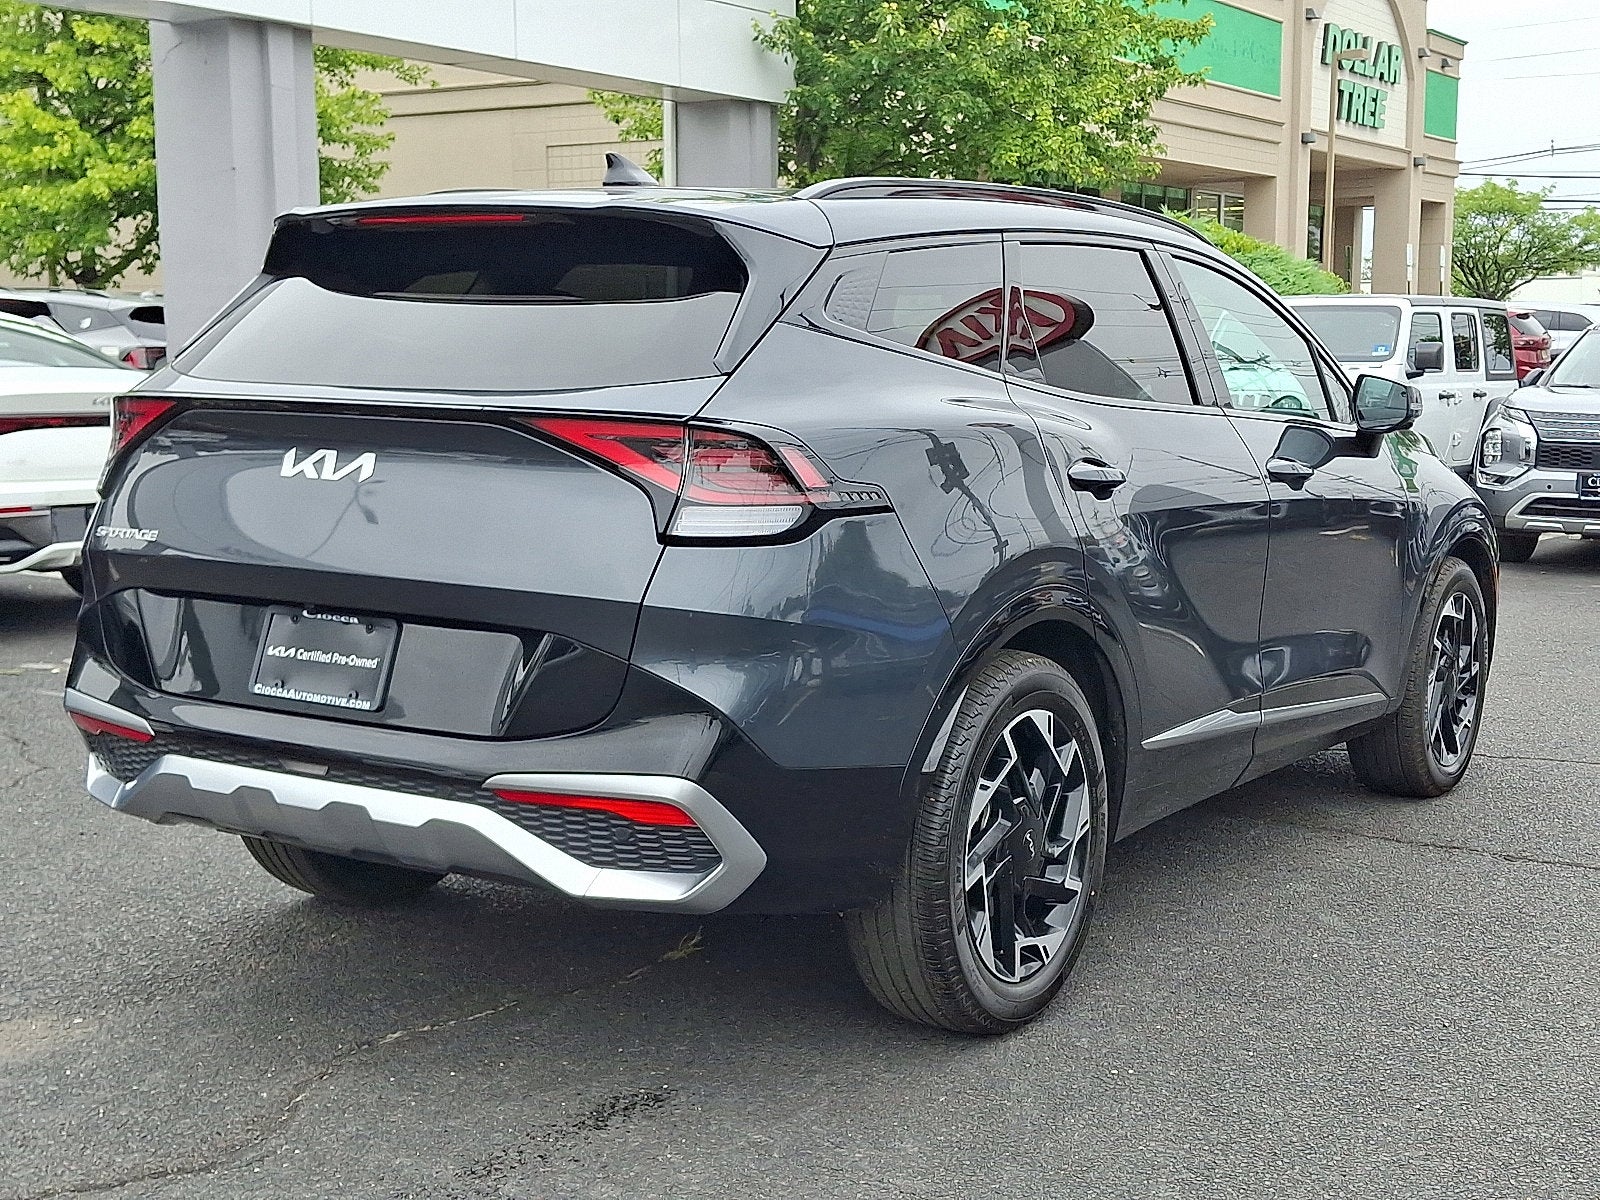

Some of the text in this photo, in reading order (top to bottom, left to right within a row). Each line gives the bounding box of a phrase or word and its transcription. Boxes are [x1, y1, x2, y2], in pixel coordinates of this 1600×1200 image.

[1321, 23, 1403, 84] DOLLAR
[1336, 79, 1388, 129] TREE
[280, 446, 377, 483] KIA
[297, 648, 333, 664] Certified
[332, 652, 380, 669] Pre-Owned
